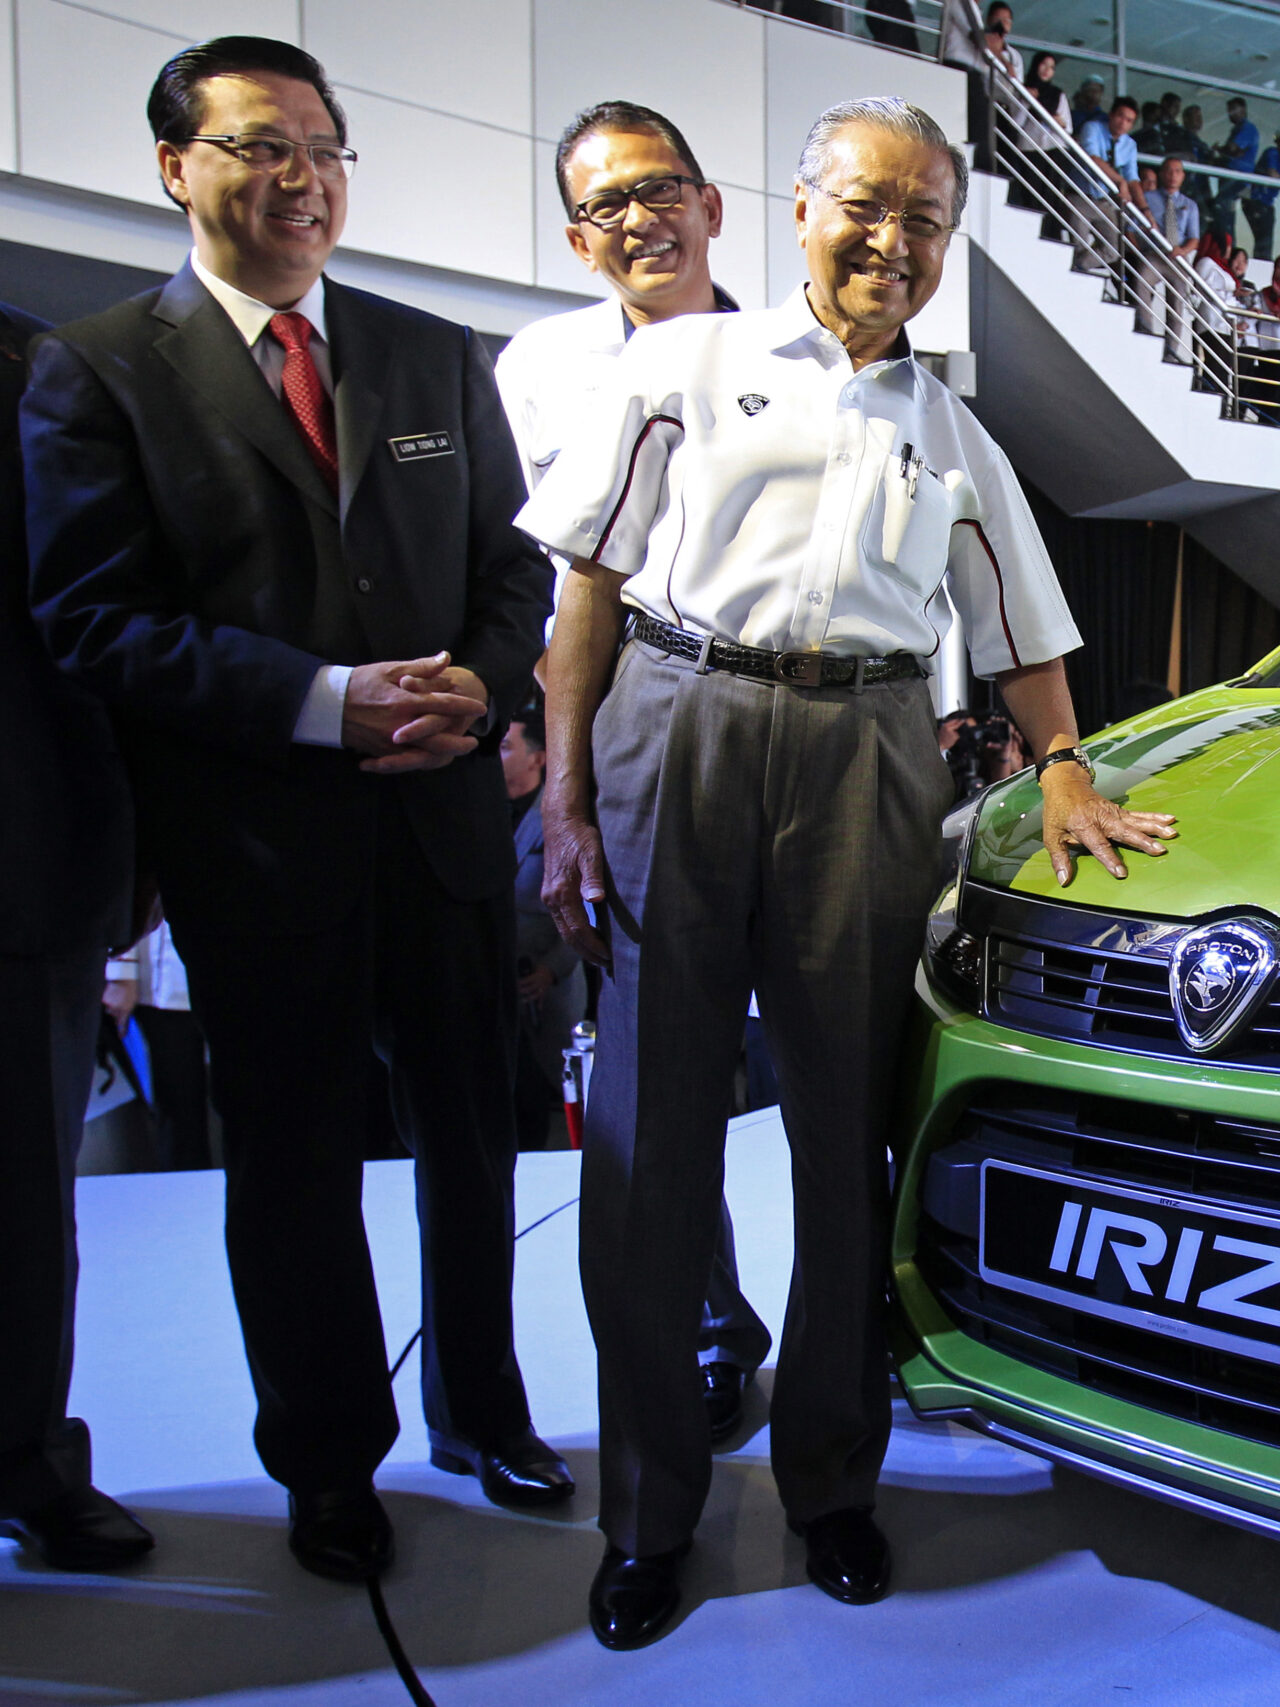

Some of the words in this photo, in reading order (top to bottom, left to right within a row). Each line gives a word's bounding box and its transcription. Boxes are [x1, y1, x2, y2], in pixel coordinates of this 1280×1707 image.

[400, 443, 416, 453] LIOW
[417, 439, 436, 449] TIONG
[437, 438, 448, 447] LAI
[1186, 941, 1254, 961] PROTON
[1160, 1198, 1180, 1208] IRIZ
